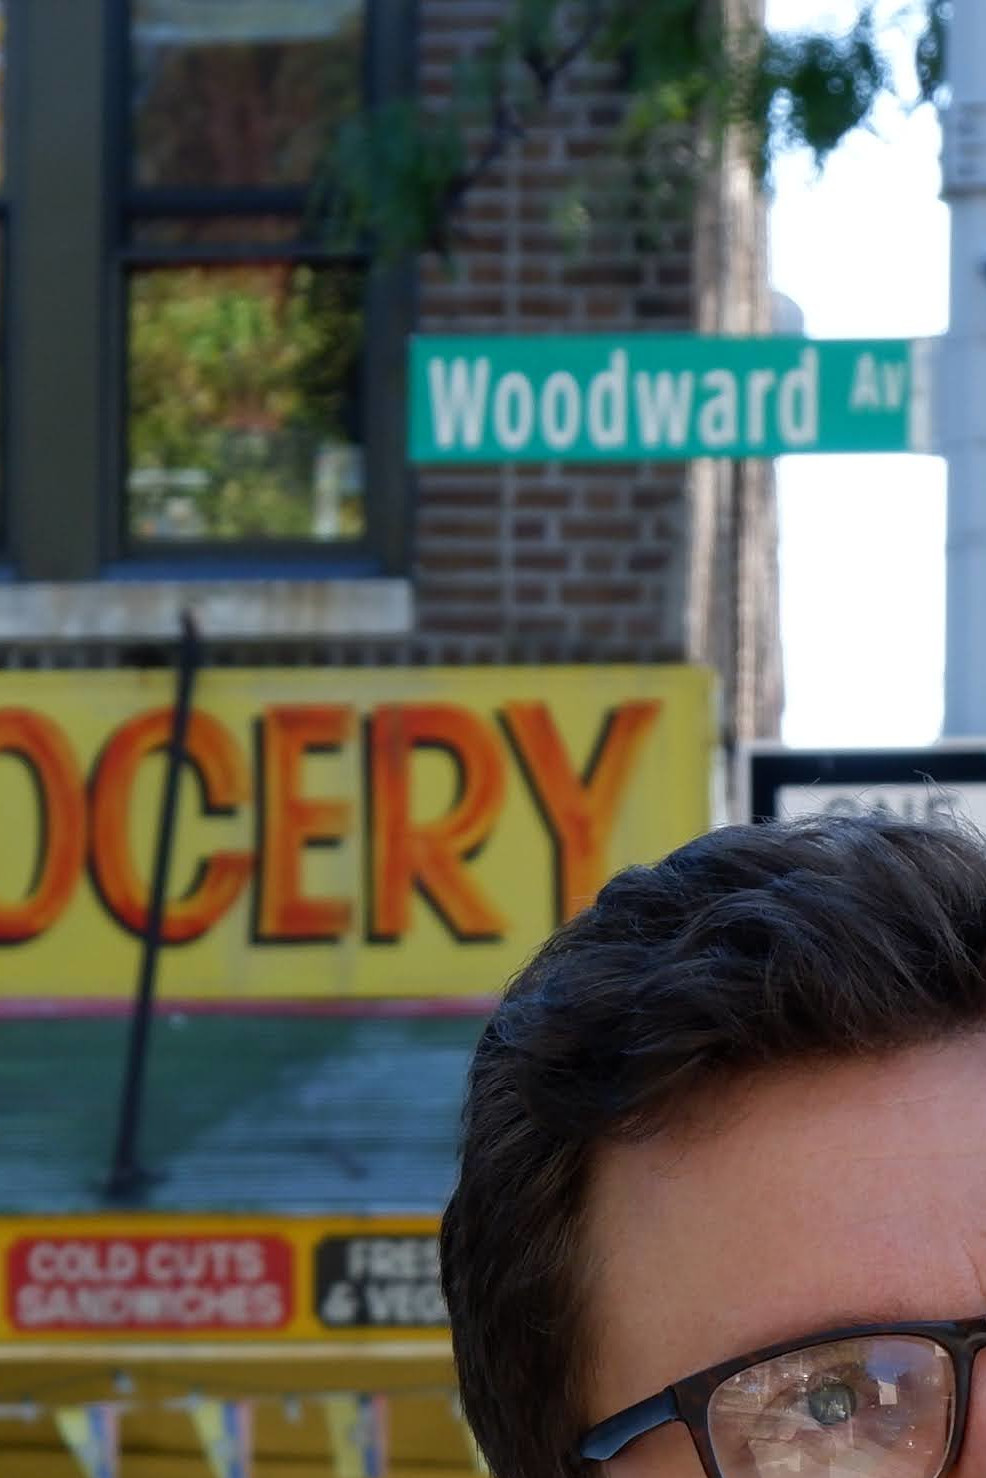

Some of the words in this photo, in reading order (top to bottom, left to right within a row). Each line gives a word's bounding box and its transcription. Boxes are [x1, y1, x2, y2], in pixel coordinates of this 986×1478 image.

[427, 347, 820, 453] Woodward
[27, 1243, 137, 1281] COLD
[145, 1241, 267, 1281] CUTS
[16, 1285, 284, 1326] SANDWICHES
